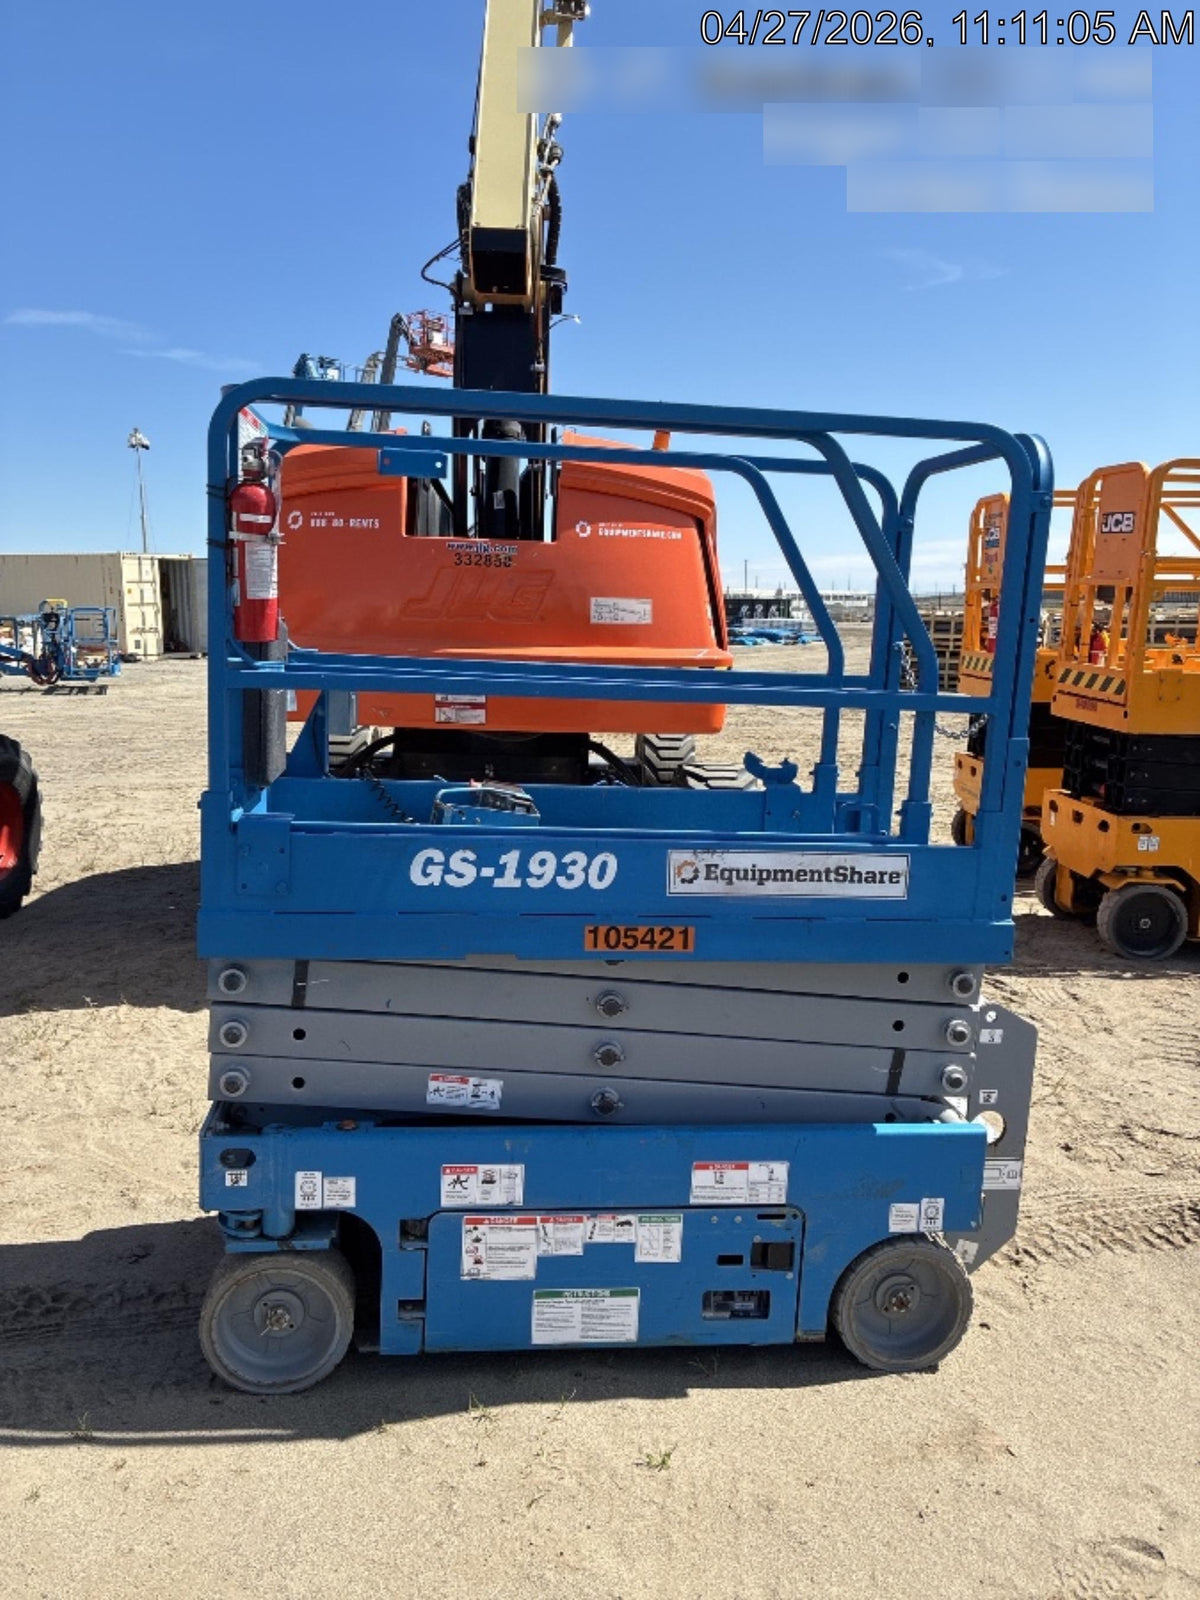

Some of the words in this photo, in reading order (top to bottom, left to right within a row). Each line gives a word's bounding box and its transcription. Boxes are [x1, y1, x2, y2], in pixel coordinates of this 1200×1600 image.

[1101, 513, 1133, 533] JCB
[409, 848, 618, 890] GS-1930
[704, 862, 901, 886] EquipmentShare
[586, 925, 693, 951] 105421
